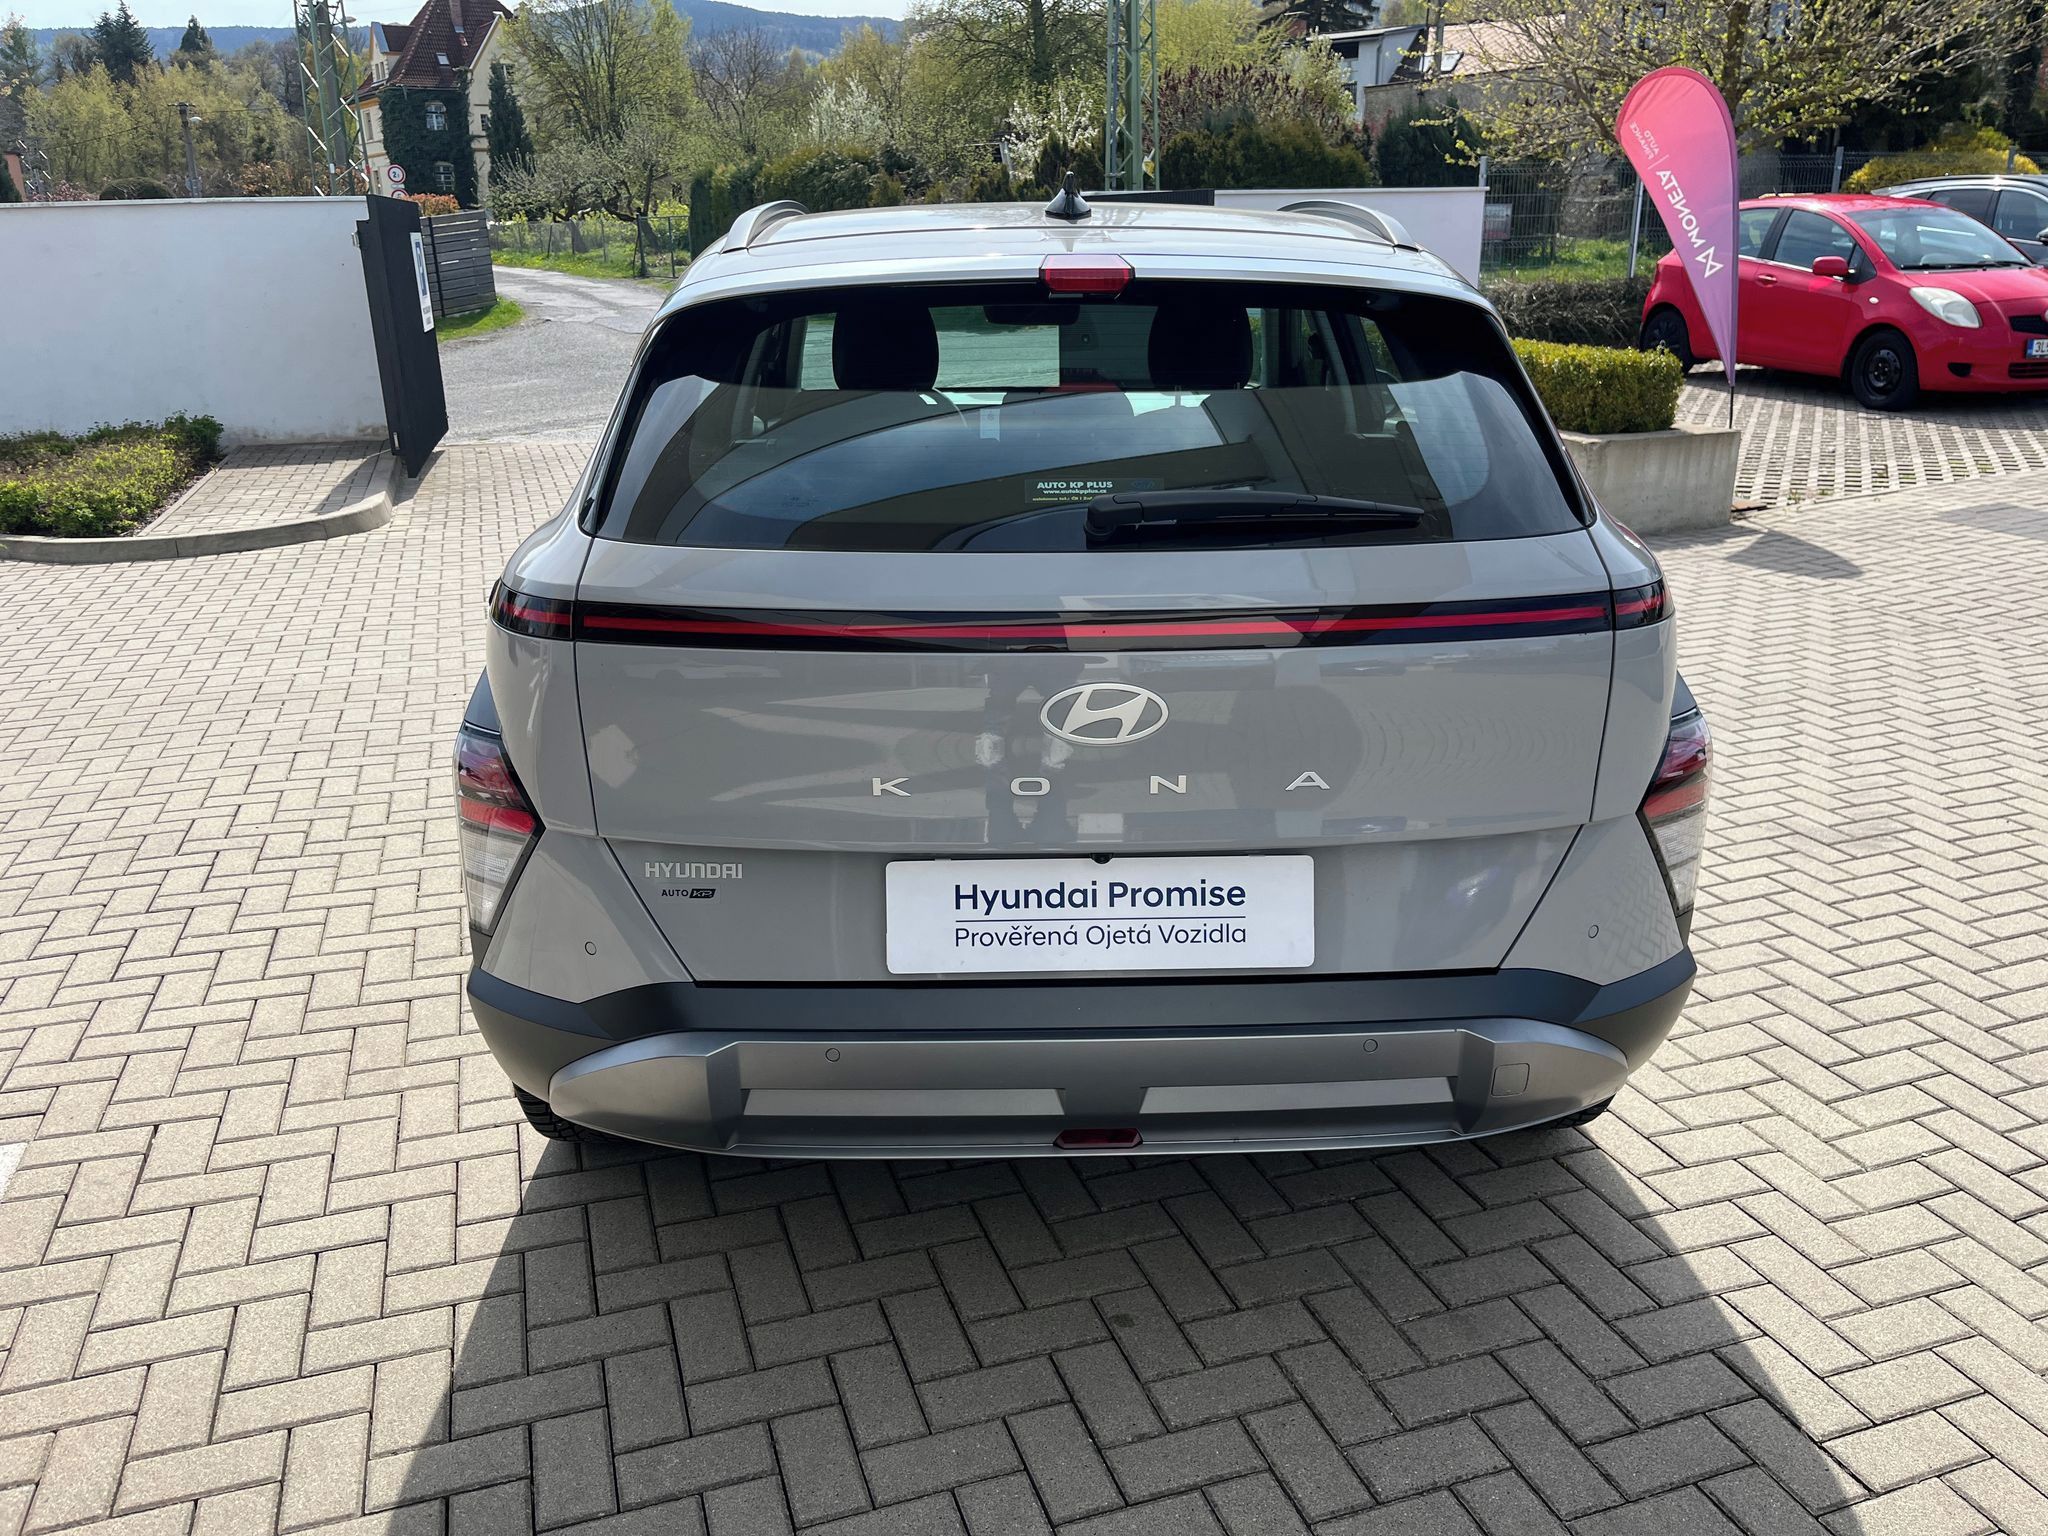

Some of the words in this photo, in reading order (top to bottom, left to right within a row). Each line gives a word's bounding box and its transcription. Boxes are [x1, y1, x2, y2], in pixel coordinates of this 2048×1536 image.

[1037, 481, 1067, 489] AUTO
[872, 771, 1330, 797] KONA
[645, 862, 742, 879] HYUNDAI
[661, 889, 689, 897] AUTO
[954, 880, 1098, 915] Hyundai
[1108, 879, 1246, 908] Promise
[955, 924, 1078, 947] Prověřená
[1086, 923, 1151, 949] Ojetá
[1158, 922, 1247, 944] Vozidla
